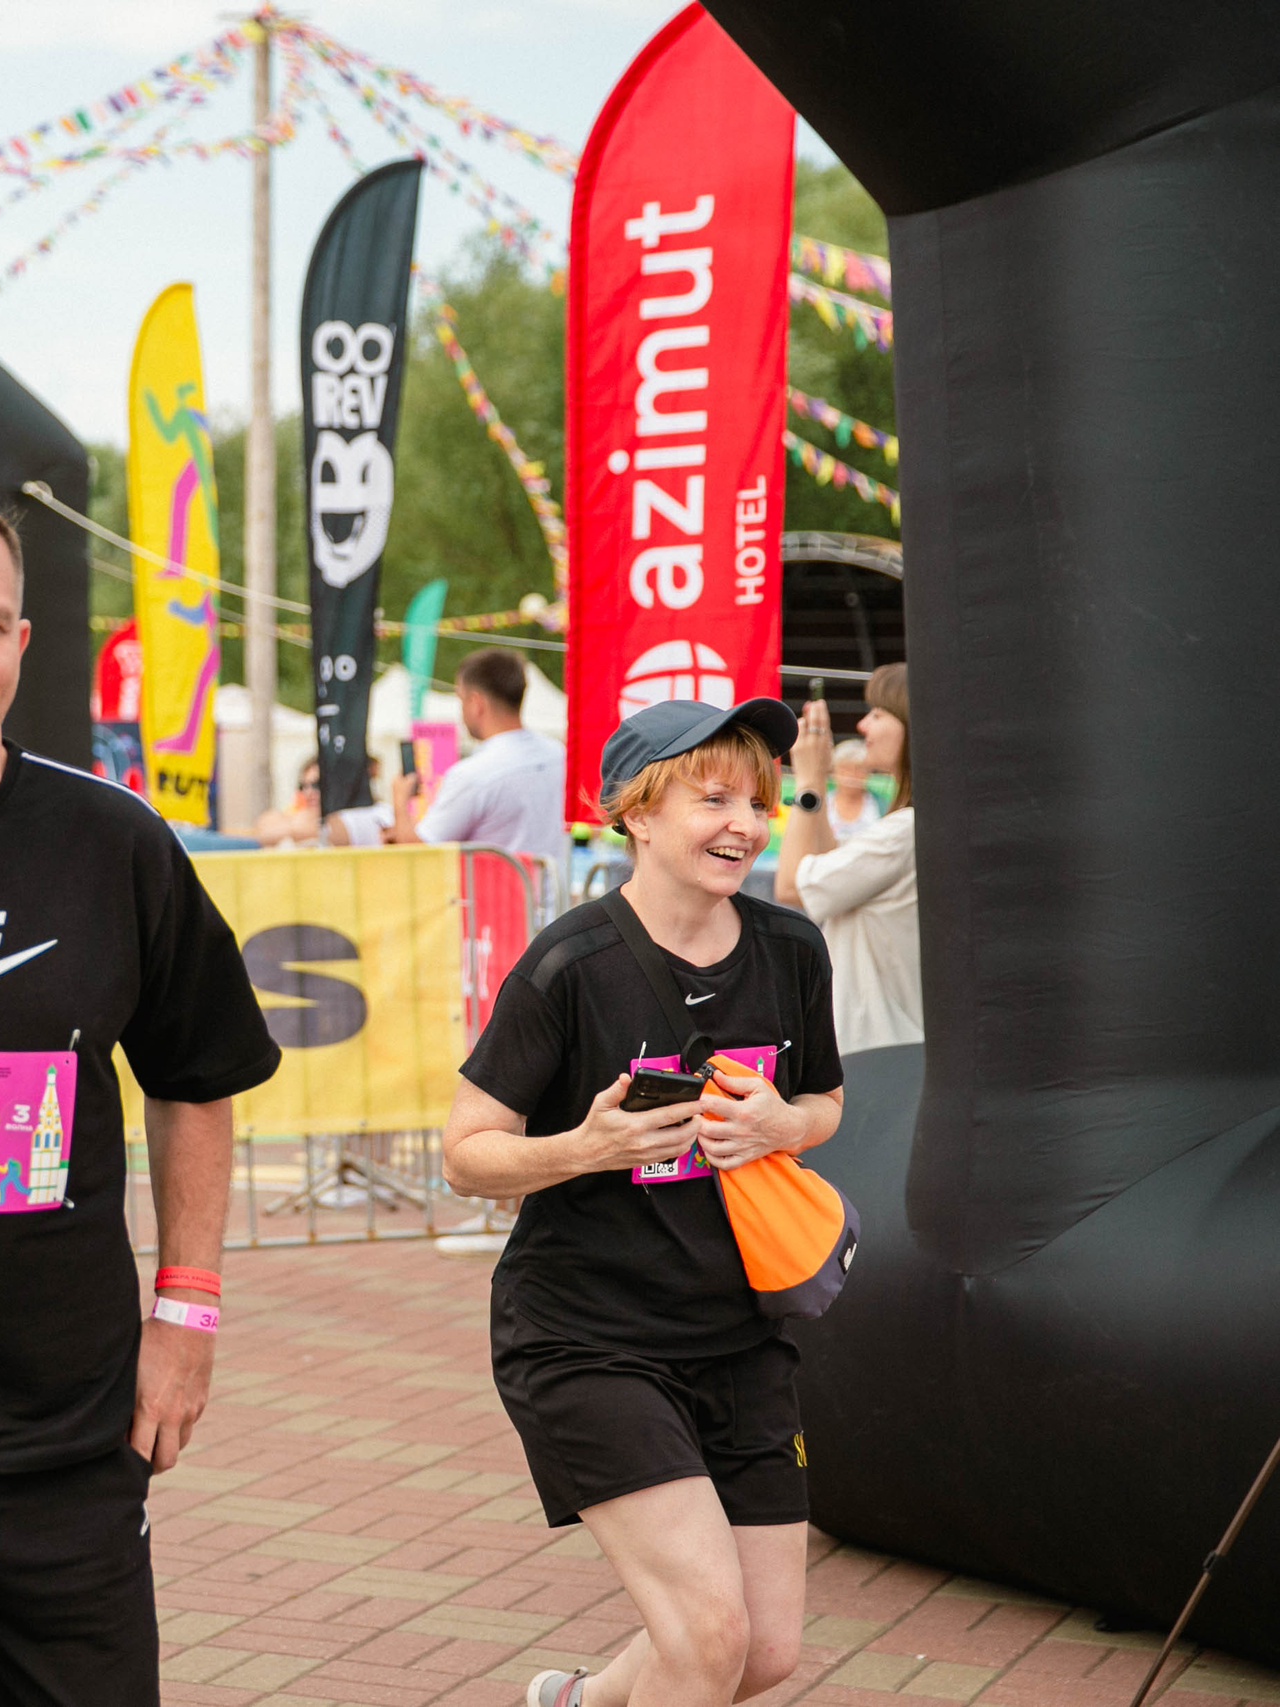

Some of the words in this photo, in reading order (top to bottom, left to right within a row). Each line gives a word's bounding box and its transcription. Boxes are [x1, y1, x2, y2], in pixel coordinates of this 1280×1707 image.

[607, 195, 715, 610] azimut
[735, 475, 767, 606] HOTEL
[12, 1104, 31, 1123] 3
